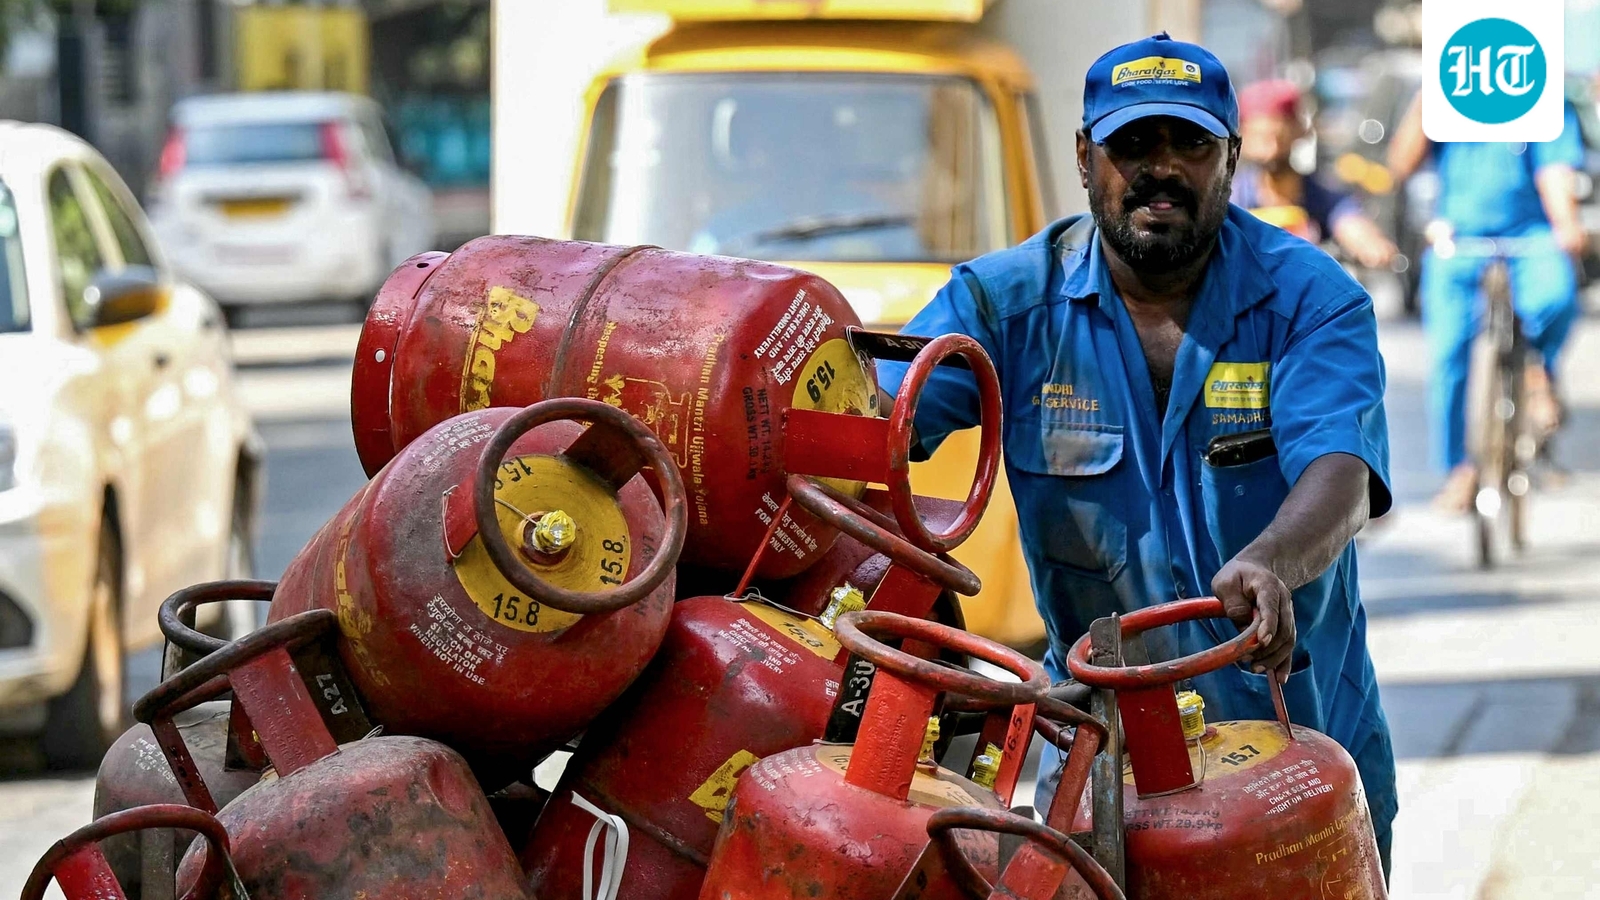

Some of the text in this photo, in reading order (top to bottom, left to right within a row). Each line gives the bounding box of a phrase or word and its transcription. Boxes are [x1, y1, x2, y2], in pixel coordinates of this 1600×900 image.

[1117, 67, 1177, 81] Bharatgas
[787, 289, 805, 314] WEIGHT
[767, 302, 810, 358] CHECK SEAL AND
[699, 333, 723, 383] Pradhan
[807, 360, 835, 403] 15.9
[692, 387, 710, 431] Mantri
[756, 388, 768, 415] NETT
[1045, 397, 1099, 412] SERVICE
[761, 491, 780, 512] केवल
[754, 507, 771, 525] FOR
[794, 548, 805, 559] USE
[493, 593, 539, 626] 15.8
[410, 623, 484, 685] WHEN NOT IN USE
[424, 629, 476, 672] REGULATOR
[464, 649, 482, 666] OFF
[316, 673, 348, 715] A27
[1221, 744, 1260, 766] 15.7
[1292, 782, 1308, 793] SEAL
[1308, 777, 1320, 787] AND
[1304, 784, 1333, 798] DELIVERY
[1254, 841, 1303, 864] Pradhan
[1302, 823, 1336, 847] Mantri
